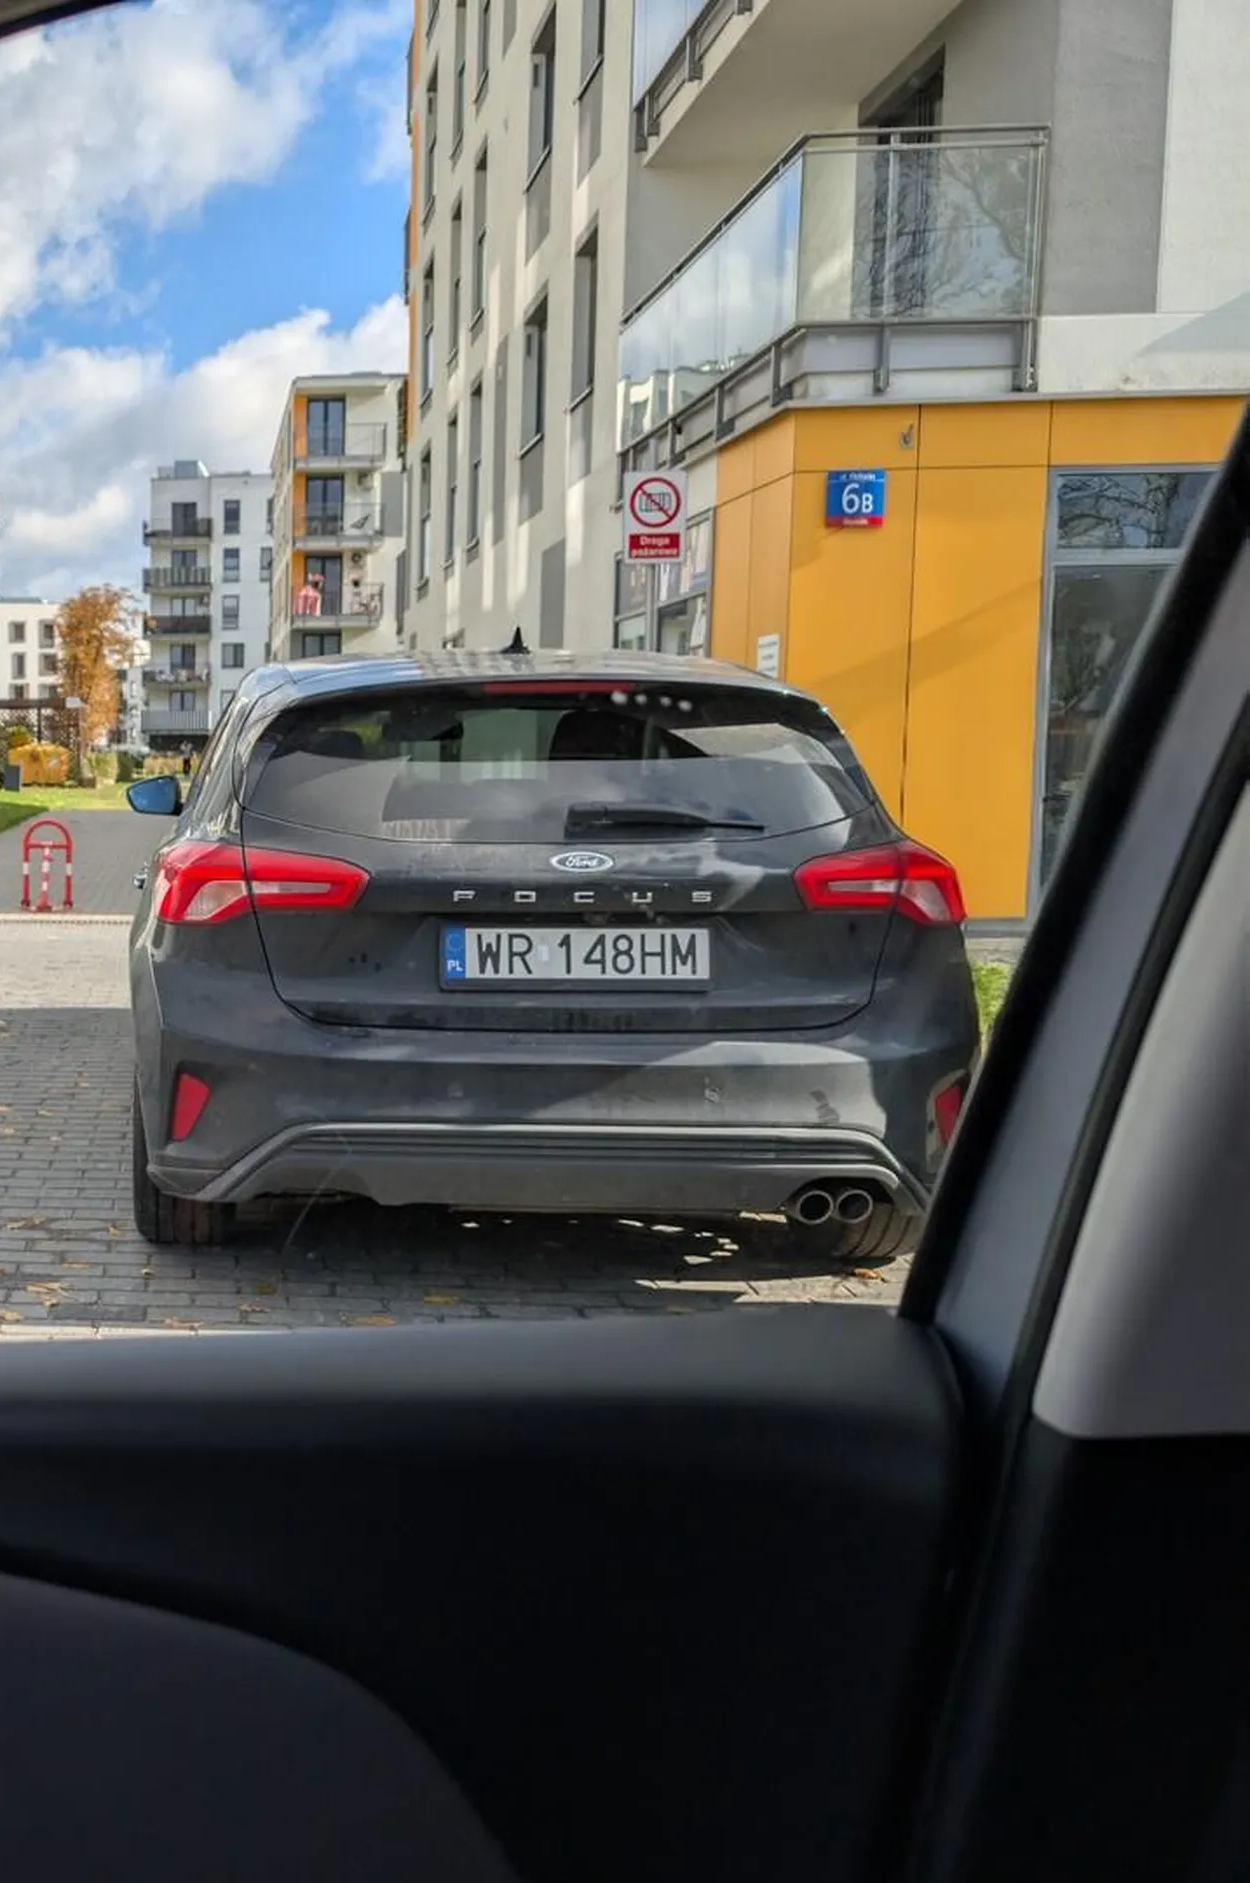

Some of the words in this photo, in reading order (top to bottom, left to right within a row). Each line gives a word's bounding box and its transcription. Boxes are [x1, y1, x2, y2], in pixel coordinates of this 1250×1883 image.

[841, 482, 873, 514] 6B
[452, 889, 713, 903] FOCUS
[447, 959, 463, 972] PL
[477, 933, 534, 975] WR
[557, 933, 698, 975] 148HM
